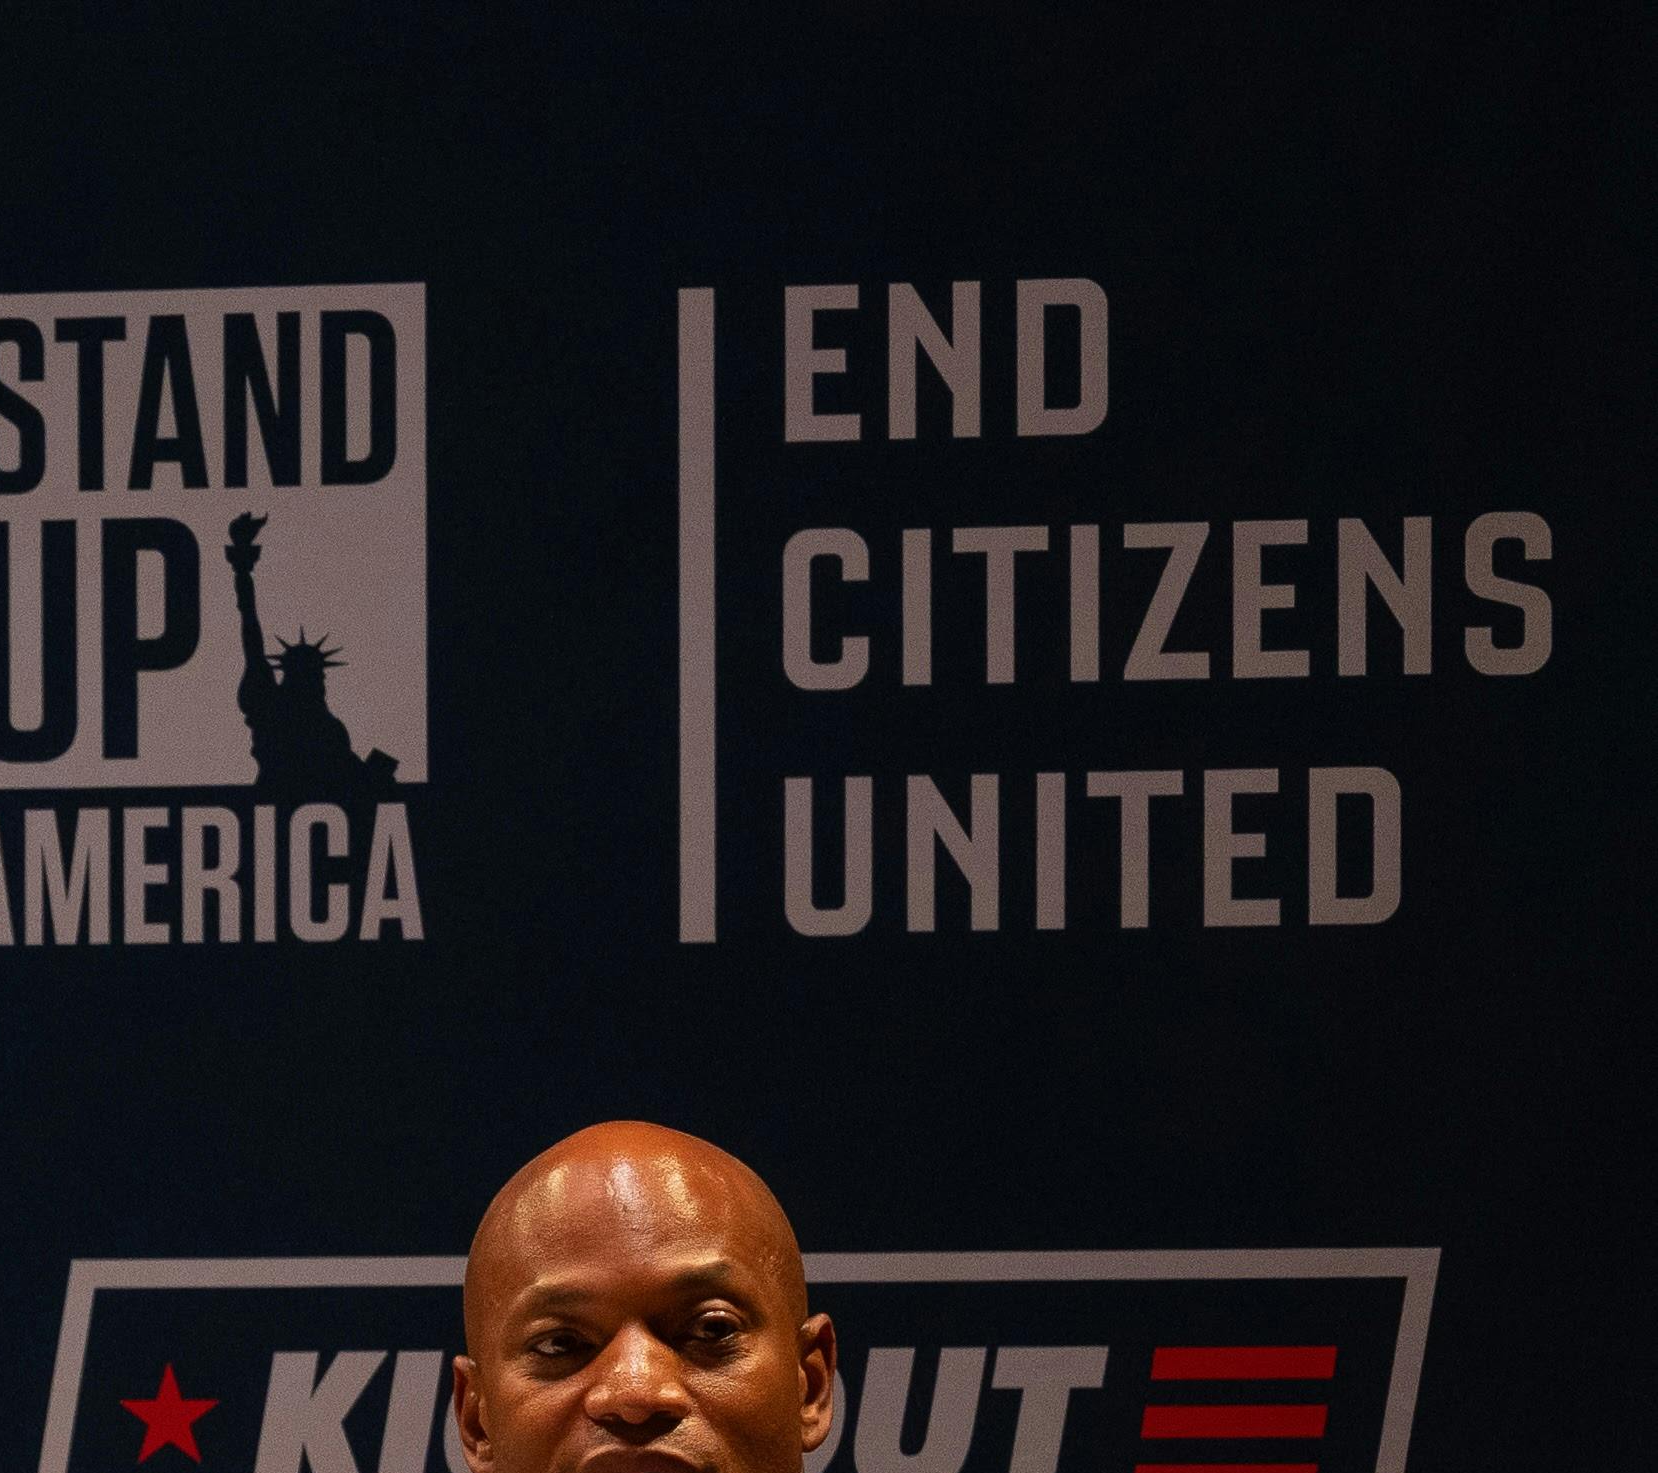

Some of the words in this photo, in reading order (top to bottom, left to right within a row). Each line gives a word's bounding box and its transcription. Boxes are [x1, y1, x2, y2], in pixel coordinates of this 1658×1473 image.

[784, 278, 1109, 443] END
[782, 512, 1553, 691] CITIZENS
[784, 766, 1402, 937] UNITED
